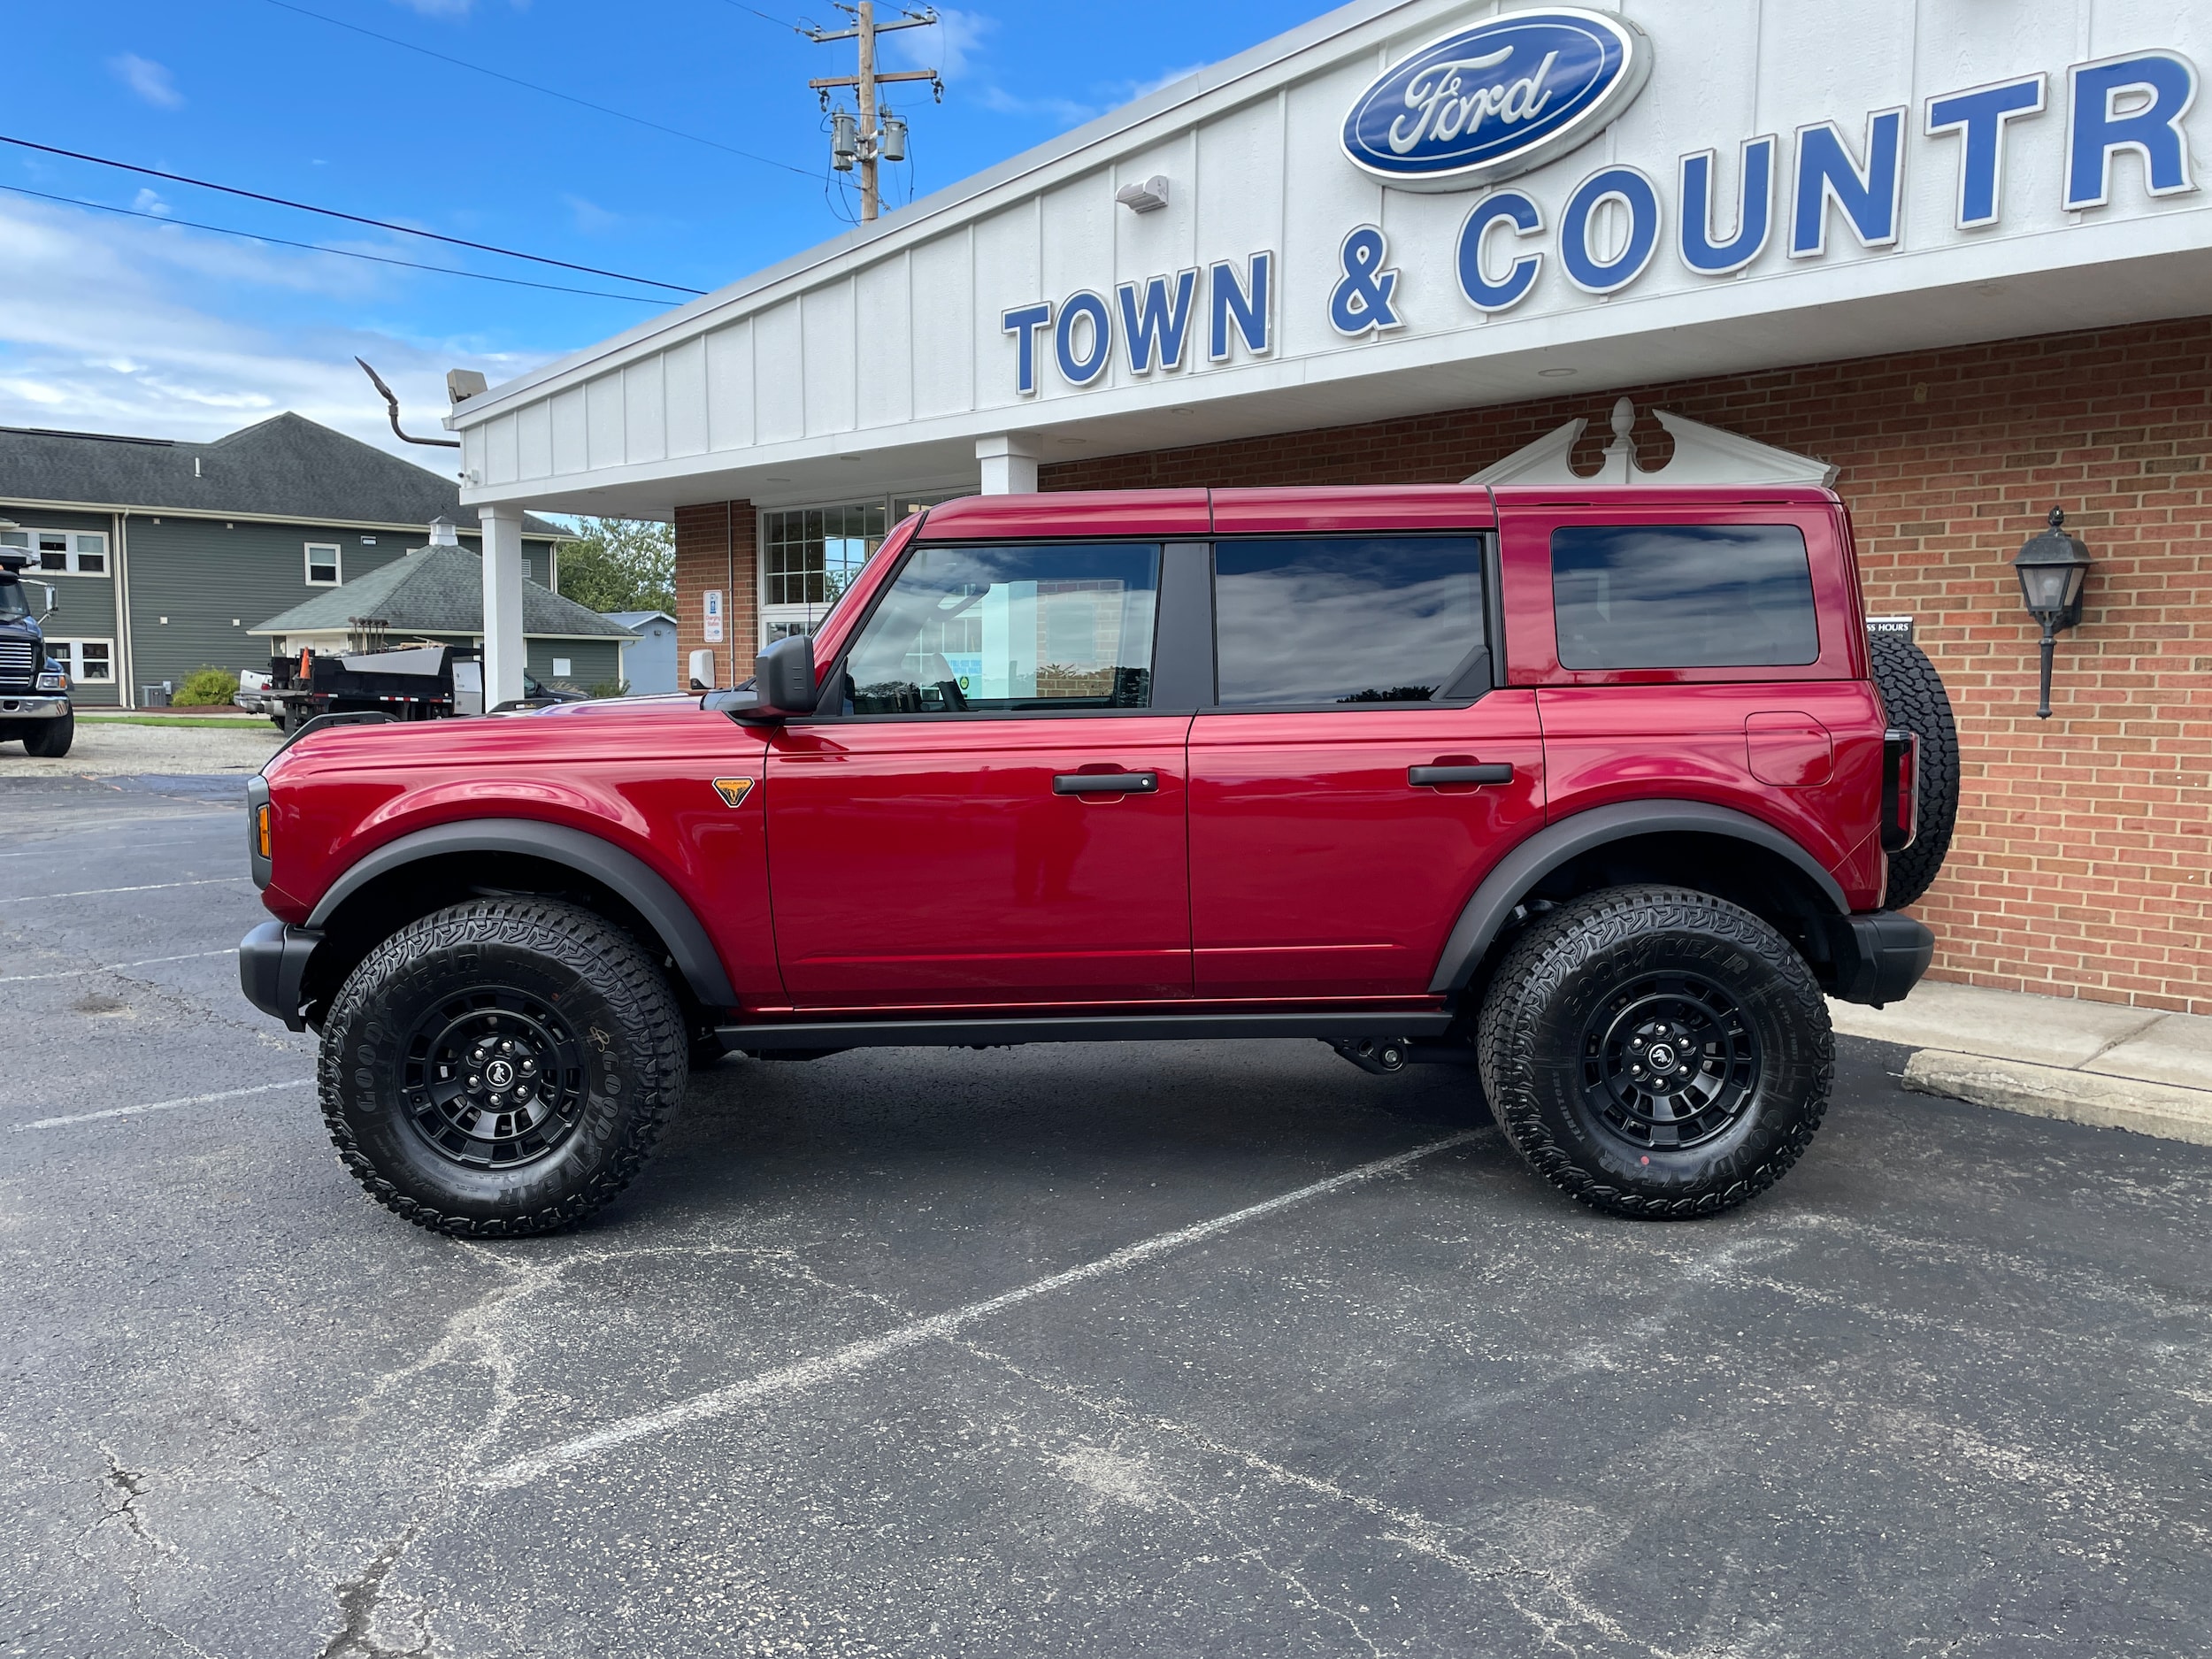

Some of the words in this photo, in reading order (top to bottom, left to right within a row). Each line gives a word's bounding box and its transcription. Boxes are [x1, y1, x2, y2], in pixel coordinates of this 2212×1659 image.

[1387, 44, 1560, 155] Ford
[1002, 250, 1274, 396] TOWN
[1328, 223, 1407, 338] &
[1878, 623, 1909, 632] HOURS
